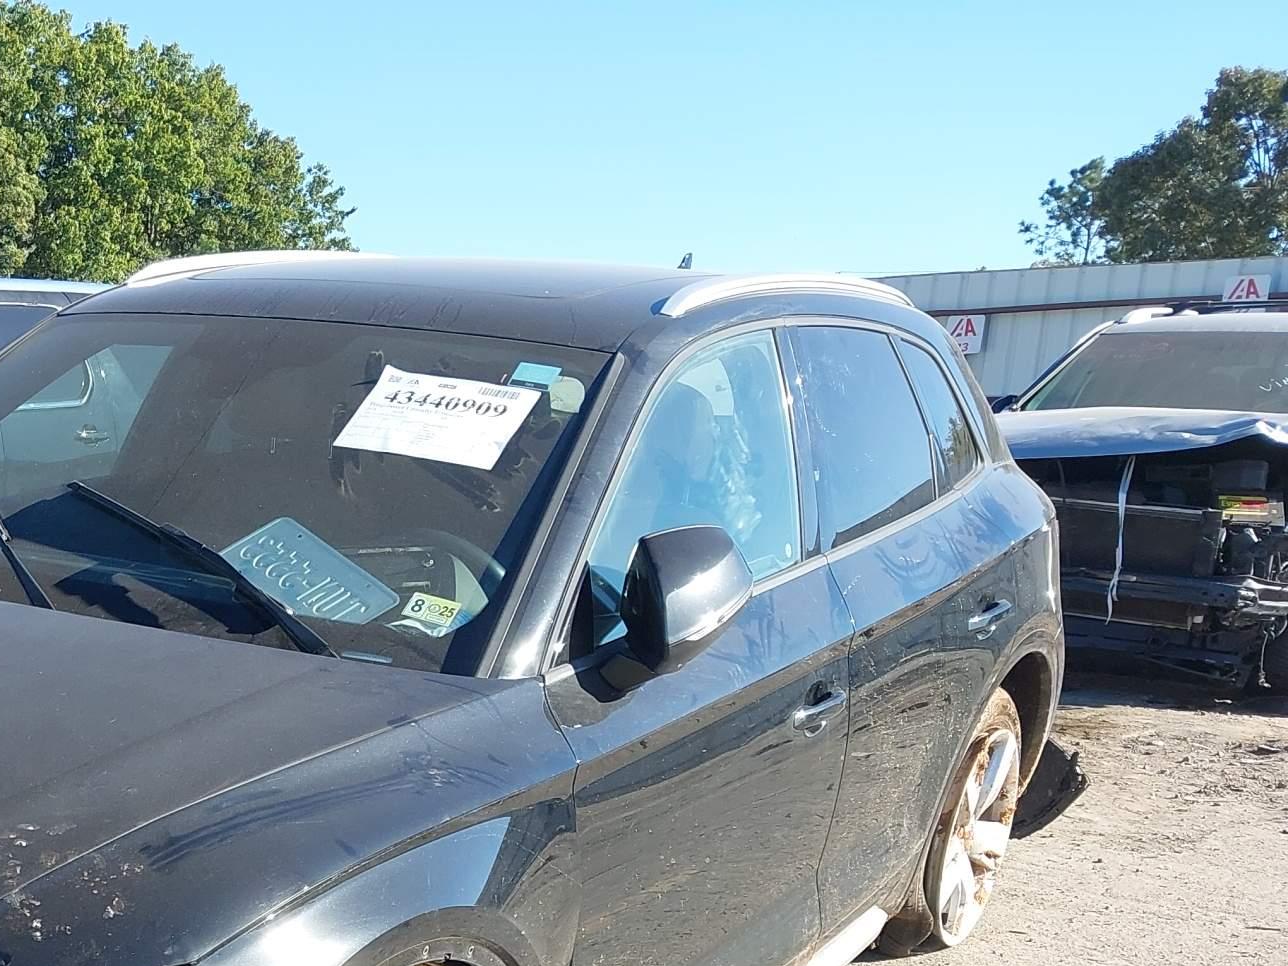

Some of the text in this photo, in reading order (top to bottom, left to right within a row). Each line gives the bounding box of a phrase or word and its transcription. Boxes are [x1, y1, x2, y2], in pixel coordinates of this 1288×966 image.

[384, 390, 508, 417] 43440909
[411, 598, 456, 618] 8 25
